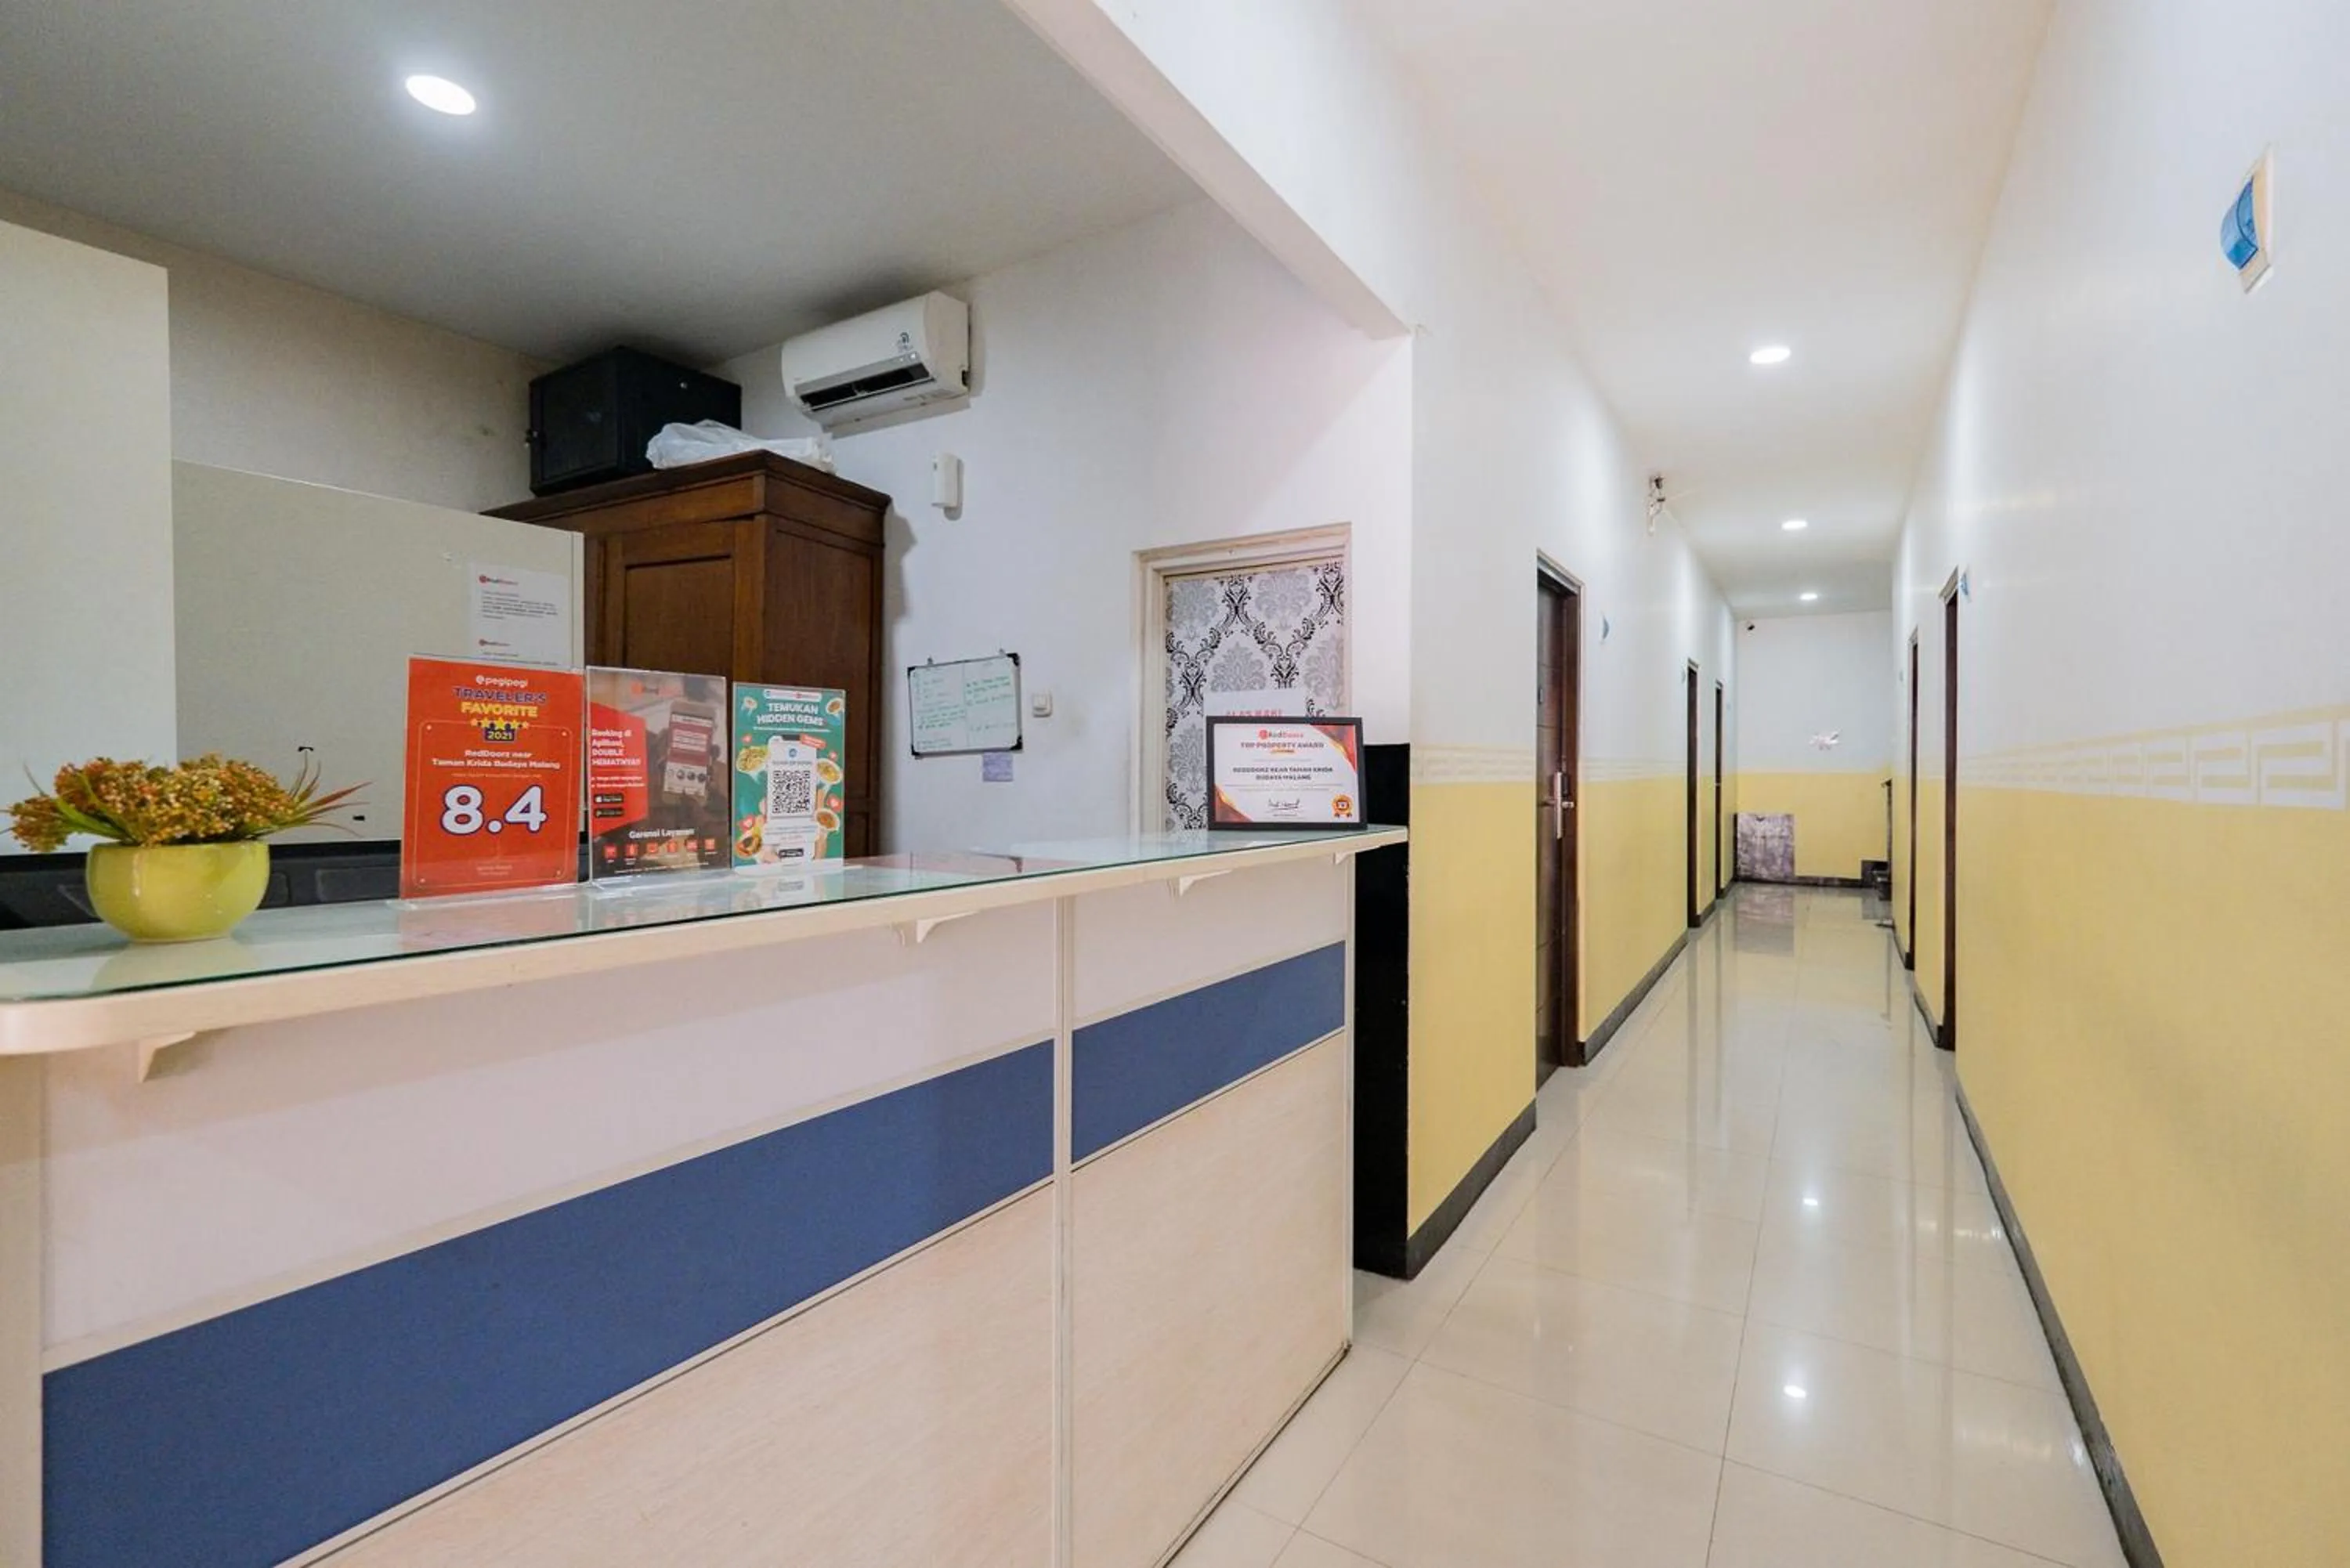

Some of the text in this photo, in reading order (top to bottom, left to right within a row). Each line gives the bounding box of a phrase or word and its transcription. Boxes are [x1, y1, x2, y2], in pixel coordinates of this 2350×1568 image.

[484, 677, 528, 688] pegipegi
[461, 701, 538, 717] FAVORITE
[768, 703, 819, 714] TEMUKAN
[757, 713, 824, 727] HIDDEN GEMS
[487, 731, 512, 740] 2021
[467, 758, 492, 767] Krida
[529, 761, 561, 769] Malang
[441, 785, 548, 835] 8.4
[628, 830, 660, 840] Garansi
